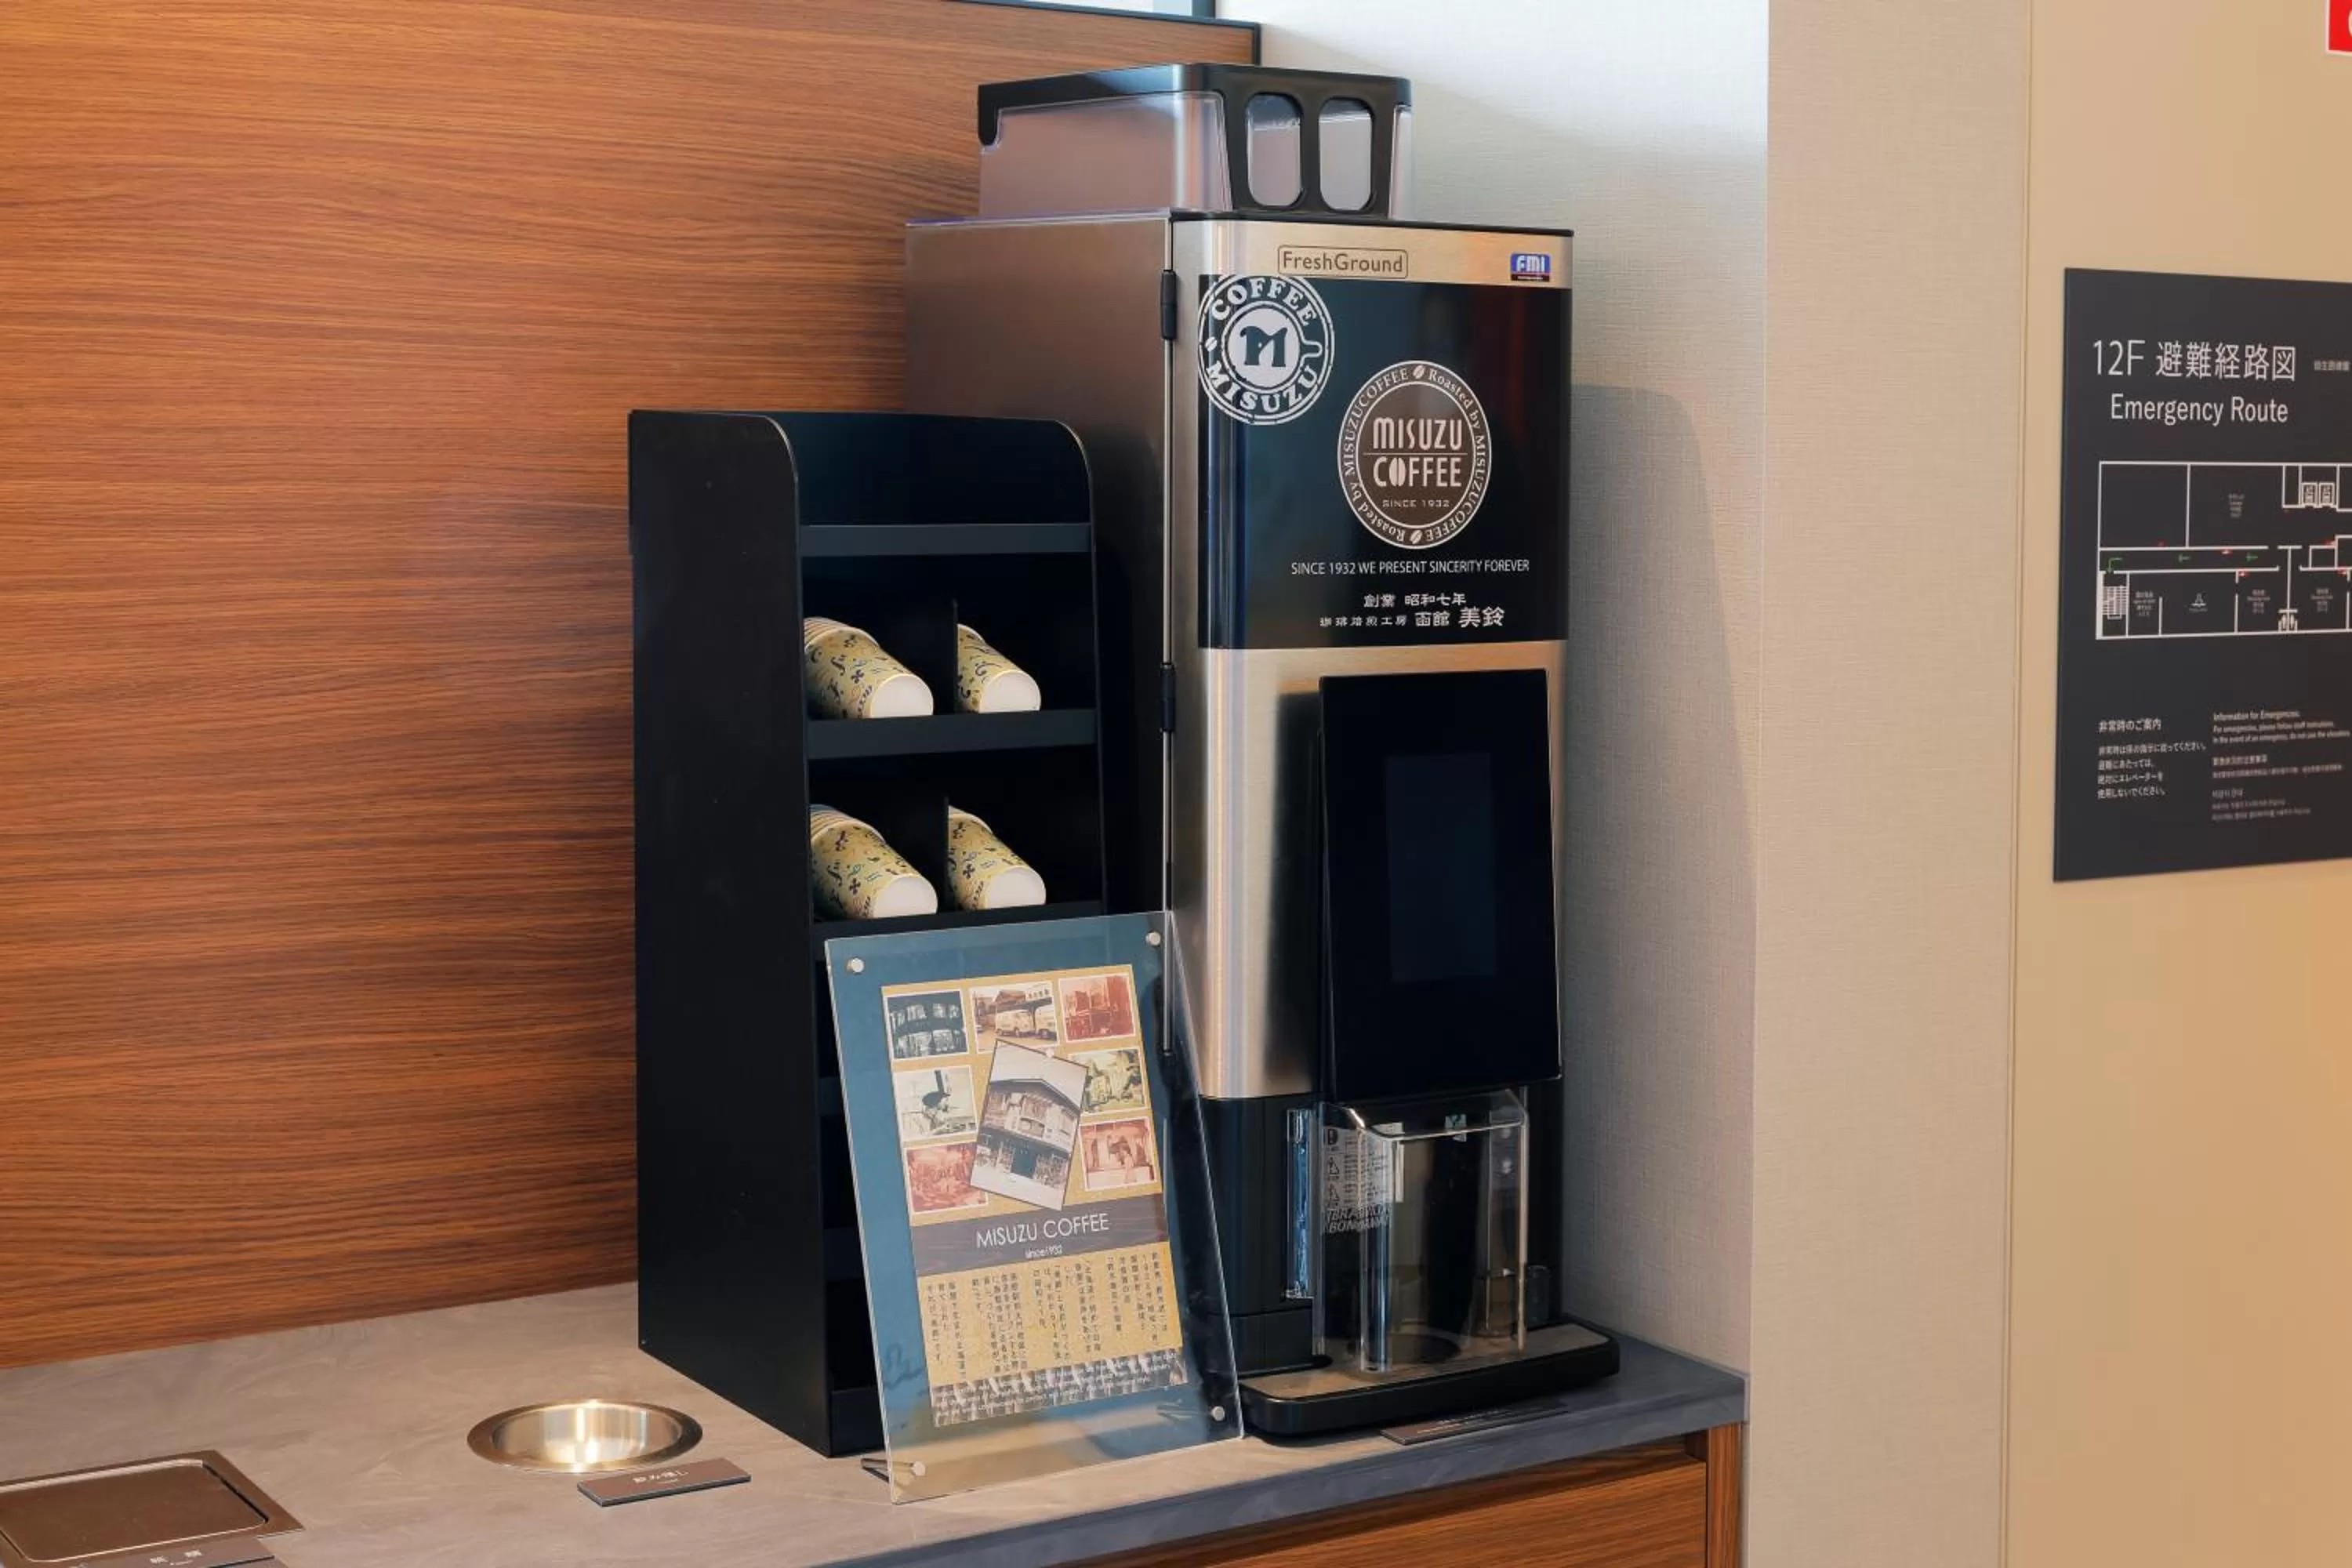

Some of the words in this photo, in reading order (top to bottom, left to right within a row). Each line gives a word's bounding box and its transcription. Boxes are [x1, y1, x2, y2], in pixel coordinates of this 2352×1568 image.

[1282, 251, 1403, 273] FreshGround
[1211, 277, 1317, 327] COFFEE
[2092, 339, 2146, 376] 12F
[2154, 340, 2296, 381] 避難経路図
[1206, 360, 1318, 413] MISUZU
[1428, 368, 1474, 412] Roasted
[1469, 409, 1481, 430] by
[1342, 367, 1409, 477] MISUZUCOFFEE
[2111, 393, 2224, 426] Emergency
[2230, 395, 2289, 424] Route
[1373, 416, 1462, 451] MISUZU
[1373, 456, 1462, 487] COFFEE
[1382, 499, 1417, 508] SINCE
[1422, 499, 1450, 508] 1932
[1357, 503, 1407, 542] Roasted
[1290, 561, 1326, 575] SINCE
[1329, 561, 1356, 575] 1932
[1358, 561, 1377, 574] WE
[1379, 561, 1428, 574] PRESENT
[1429, 560, 1483, 574] SINCERITY
[1484, 559, 1530, 572] FOREVER
[1363, 593, 1396, 608] 創業
[1404, 592, 1467, 607] 昭和七年
[1414, 610, 1450, 627] 函館
[1457, 605, 1505, 628] 美鈴
[976, 1223, 1037, 1249] MISUZU
[1043, 1213, 1109, 1239] COFFEE
